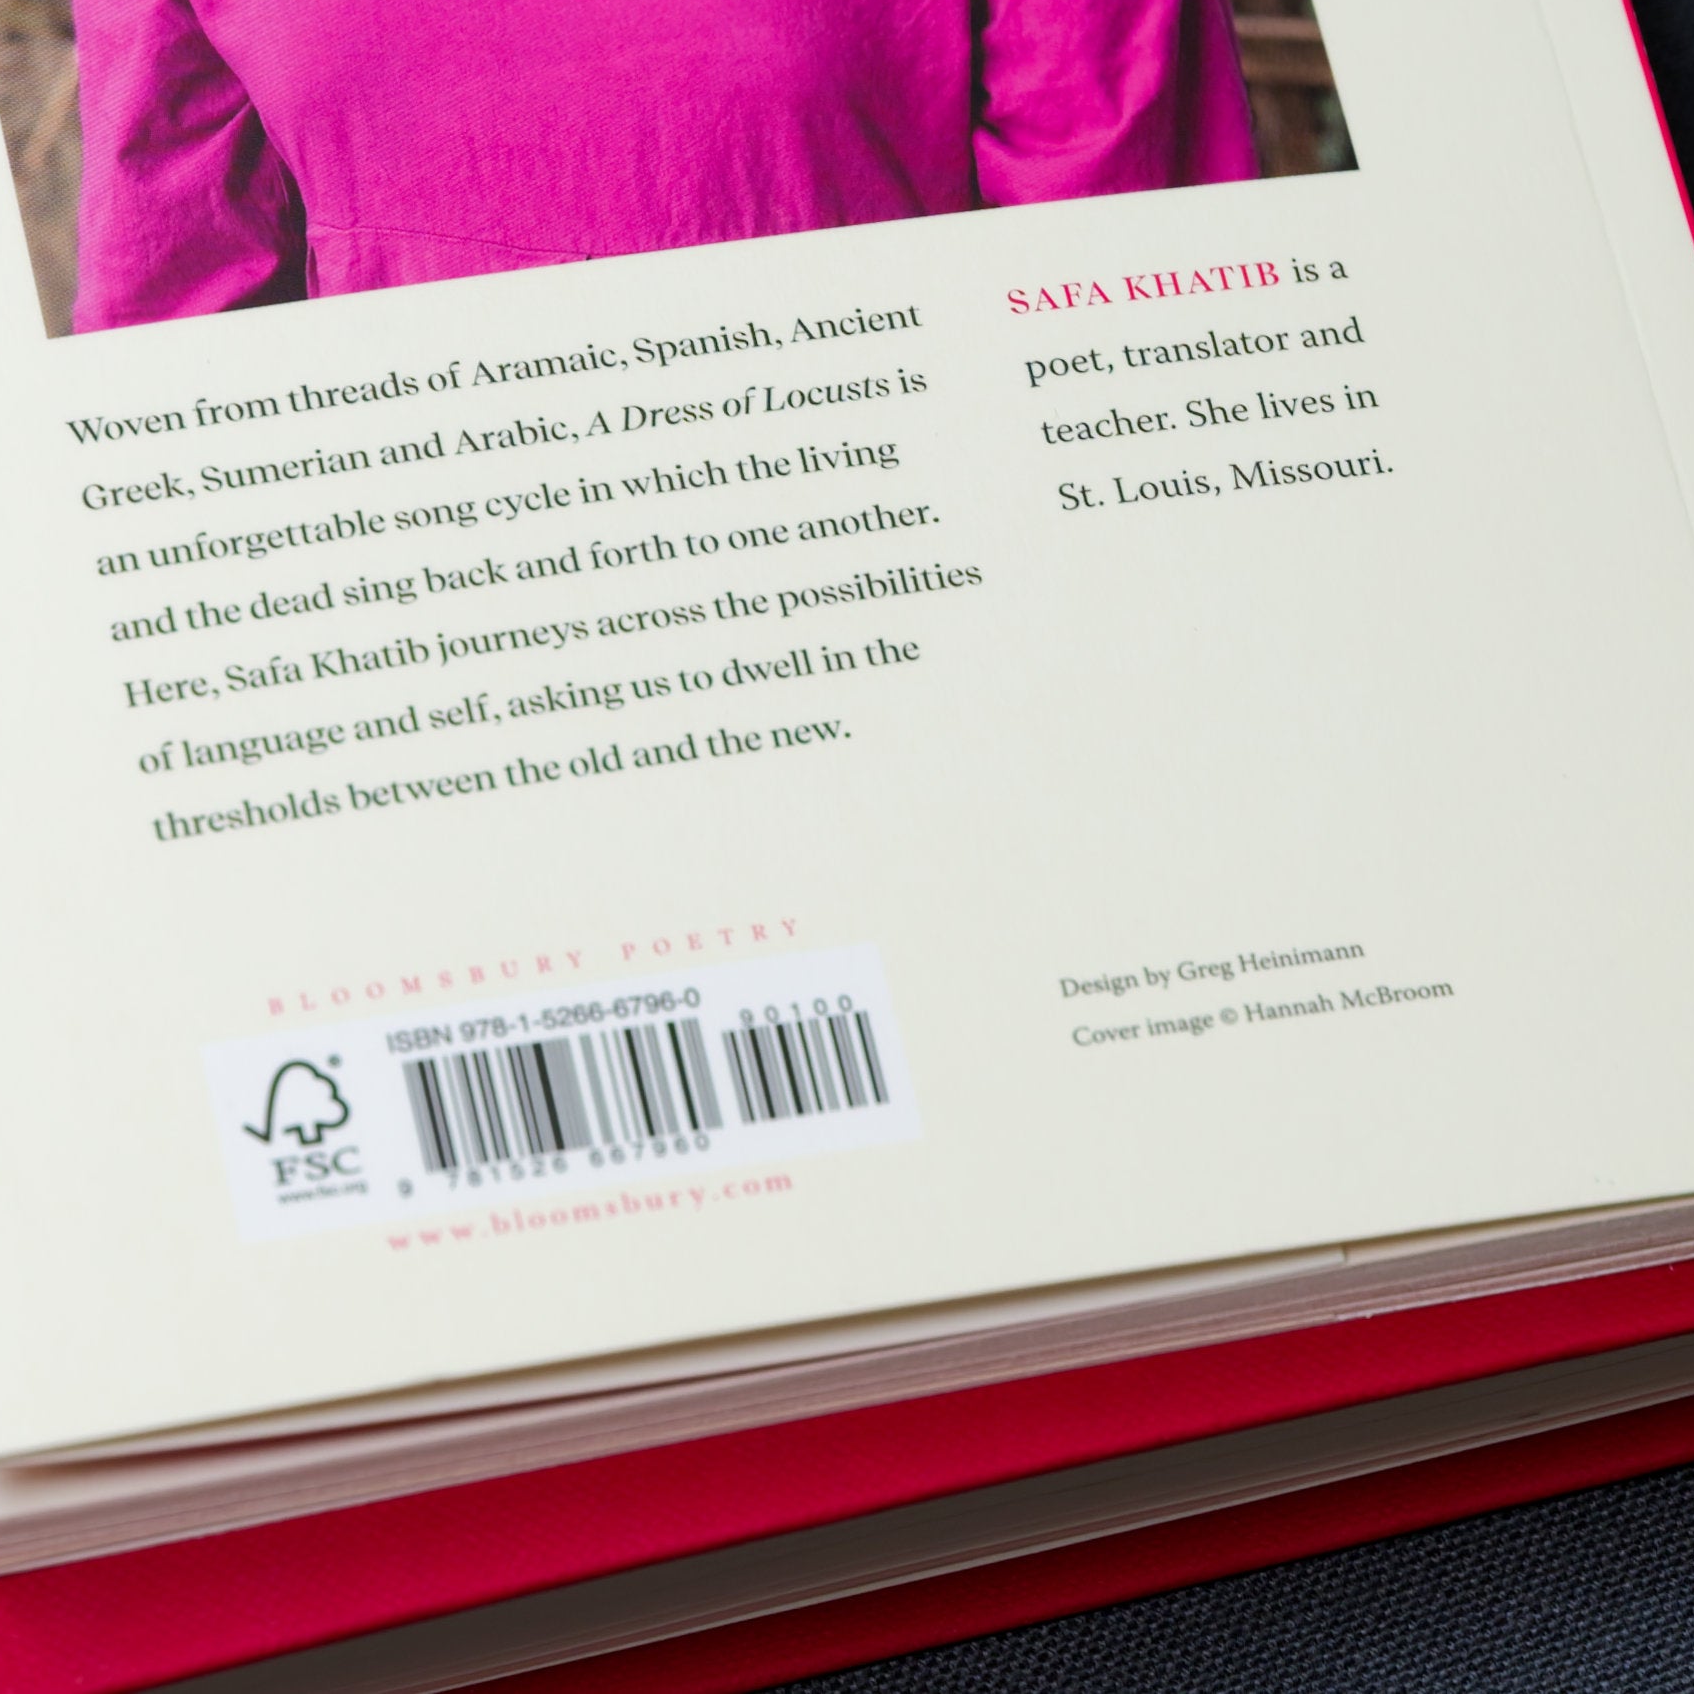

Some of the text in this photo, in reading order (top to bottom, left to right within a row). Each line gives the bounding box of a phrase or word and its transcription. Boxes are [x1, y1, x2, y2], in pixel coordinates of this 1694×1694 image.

[1008, 258, 1348, 314] SAFA KHATIB is a
[66, 306, 922, 444] Woven from threads of Aramaic, Spanish, Ancient
[1025, 316, 1365, 387] poet, translator and
[82, 369, 927, 510] Greek, Sumerian and Arabic, A Dress of Locusts is
[1041, 385, 1379, 444] teacher. She lives in
[97, 442, 899, 575] an unforgettable song cycle in which the living
[1059, 449, 1393, 510] St. Louis, Missouri.
[111, 504, 939, 641] and the dead sing back and forth to one another.
[124, 563, 982, 707] Here, Safa Khatib journeys across the possibilities
[139, 638, 919, 773] of language and self, asking us to dwell in the
[153, 720, 851, 841] thresholds between the old and the new.
[266, 918, 803, 1017] BLOOMSBURY POETRY
[1060, 944, 1365, 998] Design by Greg Heinimann
[386, 986, 702, 1055] ISBN 978-1-5266-6796-0
[738, 994, 855, 1027] 90100
[1072, 983, 1454, 1046] Cover image © Hannah McBroom
[272, 1147, 365, 1188] FSC
[397, 1132, 711, 1199] 9 781526 667960
[386, 1169, 795, 1253] www.bloomsbury.com
